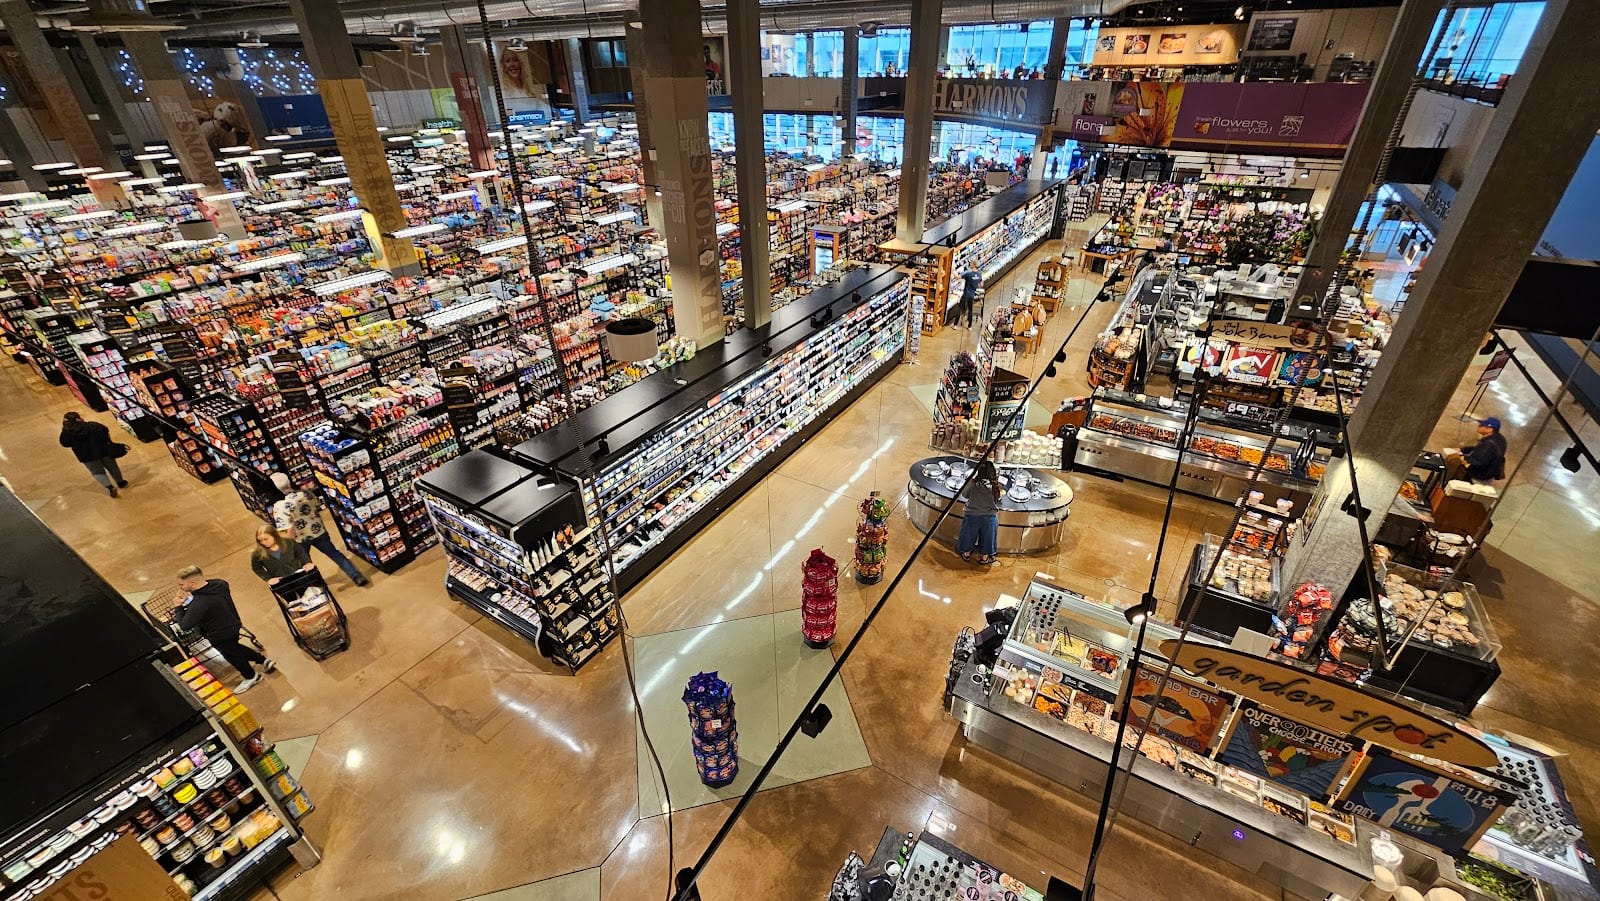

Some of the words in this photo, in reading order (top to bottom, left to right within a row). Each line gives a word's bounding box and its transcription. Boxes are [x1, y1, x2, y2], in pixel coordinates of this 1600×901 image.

[933, 79, 1028, 115] HARMONS
[426, 120, 454, 129] health
[509, 113, 543, 122] pharmacy
[1211, 116, 1269, 129] flowers
[1247, 126, 1273, 135] you!
[354, 133, 410, 261] HARMOS
[1210, 322, 1247, 339] Wok
[1139, 670, 1183, 693] SALAD
[1188, 687, 1220, 706] BAR
[1174, 655, 1334, 713] garden
[1244, 707, 1281, 728] OVER
[1280, 720, 1310, 738] 90
[1308, 729, 1354, 753] ITEMS
[1248, 718, 1261, 727] TO
[1268, 726, 1307, 745] CHOOSE
[1313, 742, 1343, 756] FROM
[1342, 800, 1378, 820] DAILY
